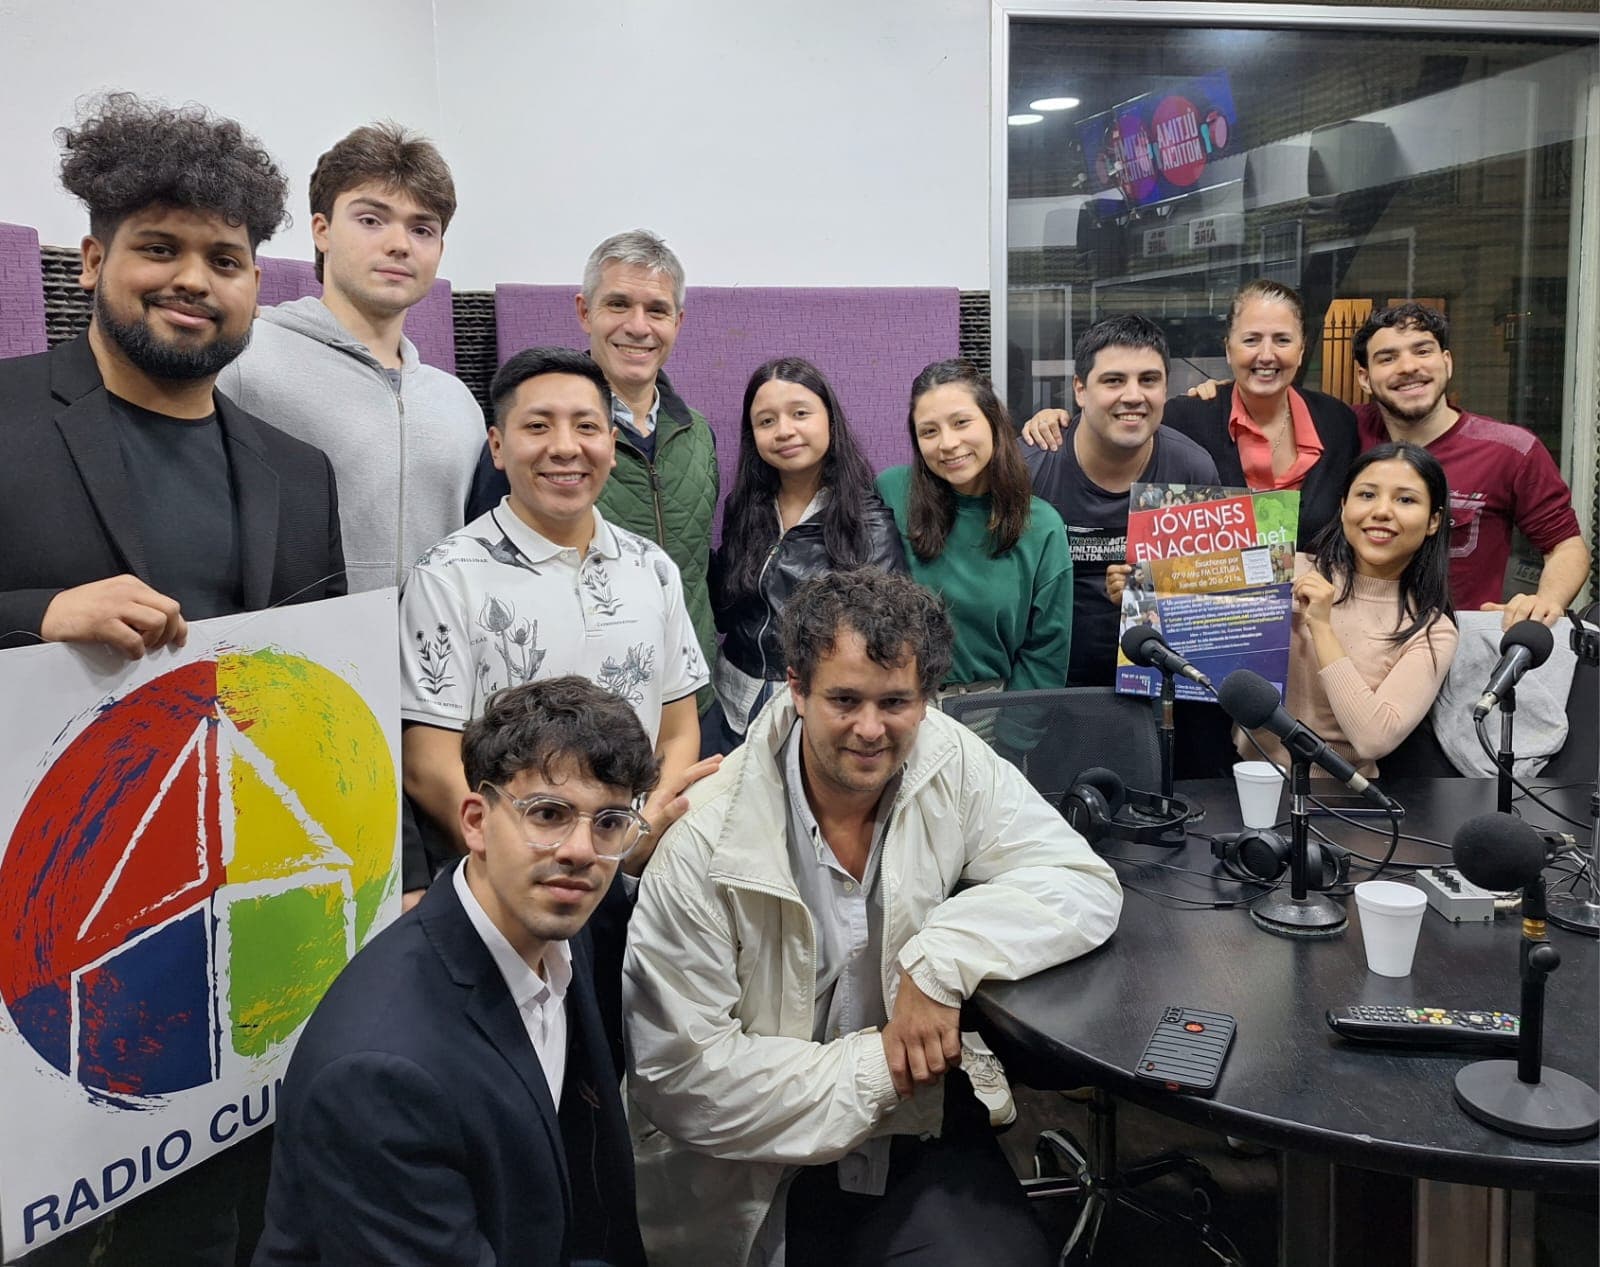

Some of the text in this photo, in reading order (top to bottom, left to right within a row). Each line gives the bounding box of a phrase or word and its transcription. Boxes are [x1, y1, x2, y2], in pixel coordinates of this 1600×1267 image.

[1152, 503, 1245, 536] JÓVENES
[23, 1078, 282, 1245] RADIO CU
